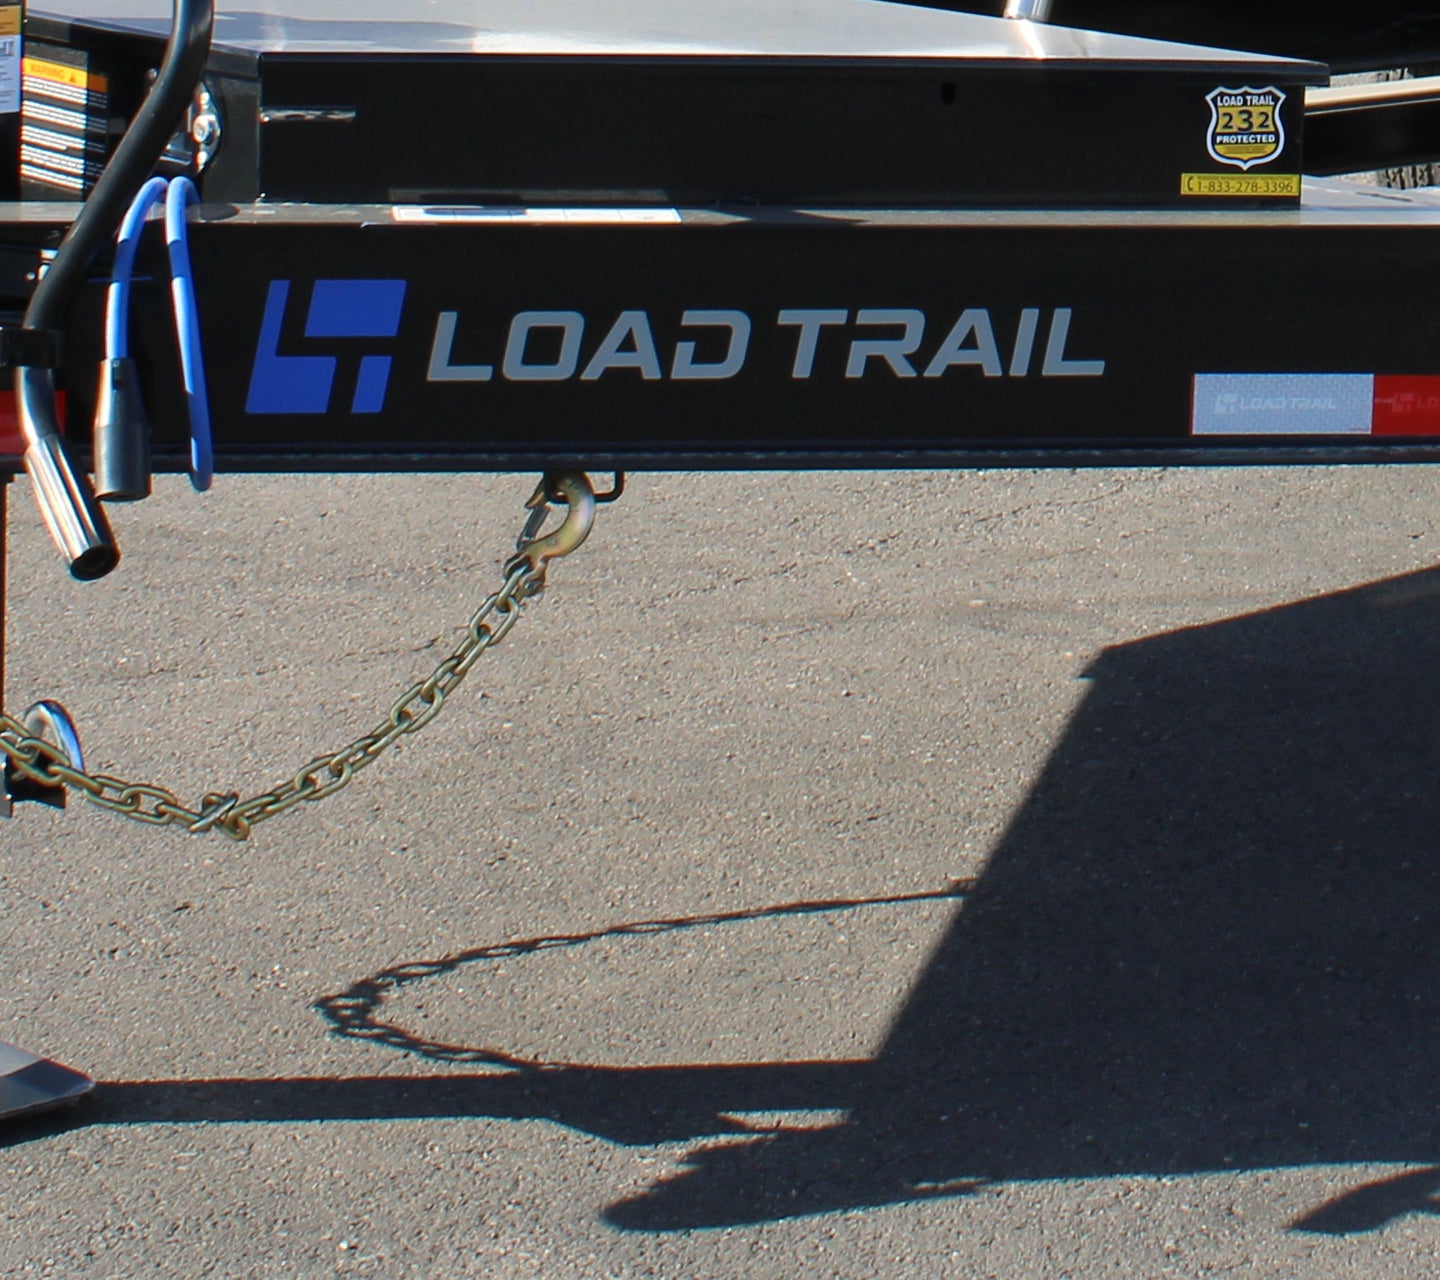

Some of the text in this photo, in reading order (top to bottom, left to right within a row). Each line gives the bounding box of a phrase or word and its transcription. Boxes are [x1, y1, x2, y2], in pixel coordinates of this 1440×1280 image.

[1217, 95, 1275, 106] LOAD TRAIL
[1222, 109, 1270, 133] 232
[1216, 134, 1276, 144] PROTECTED
[1198, 181, 1293, 193] 1-833-278-3396
[426, 310, 752, 381] LOAD
[777, 307, 1106, 379] TRAIL
[1240, 396, 1336, 410] LOAD TRAIL
